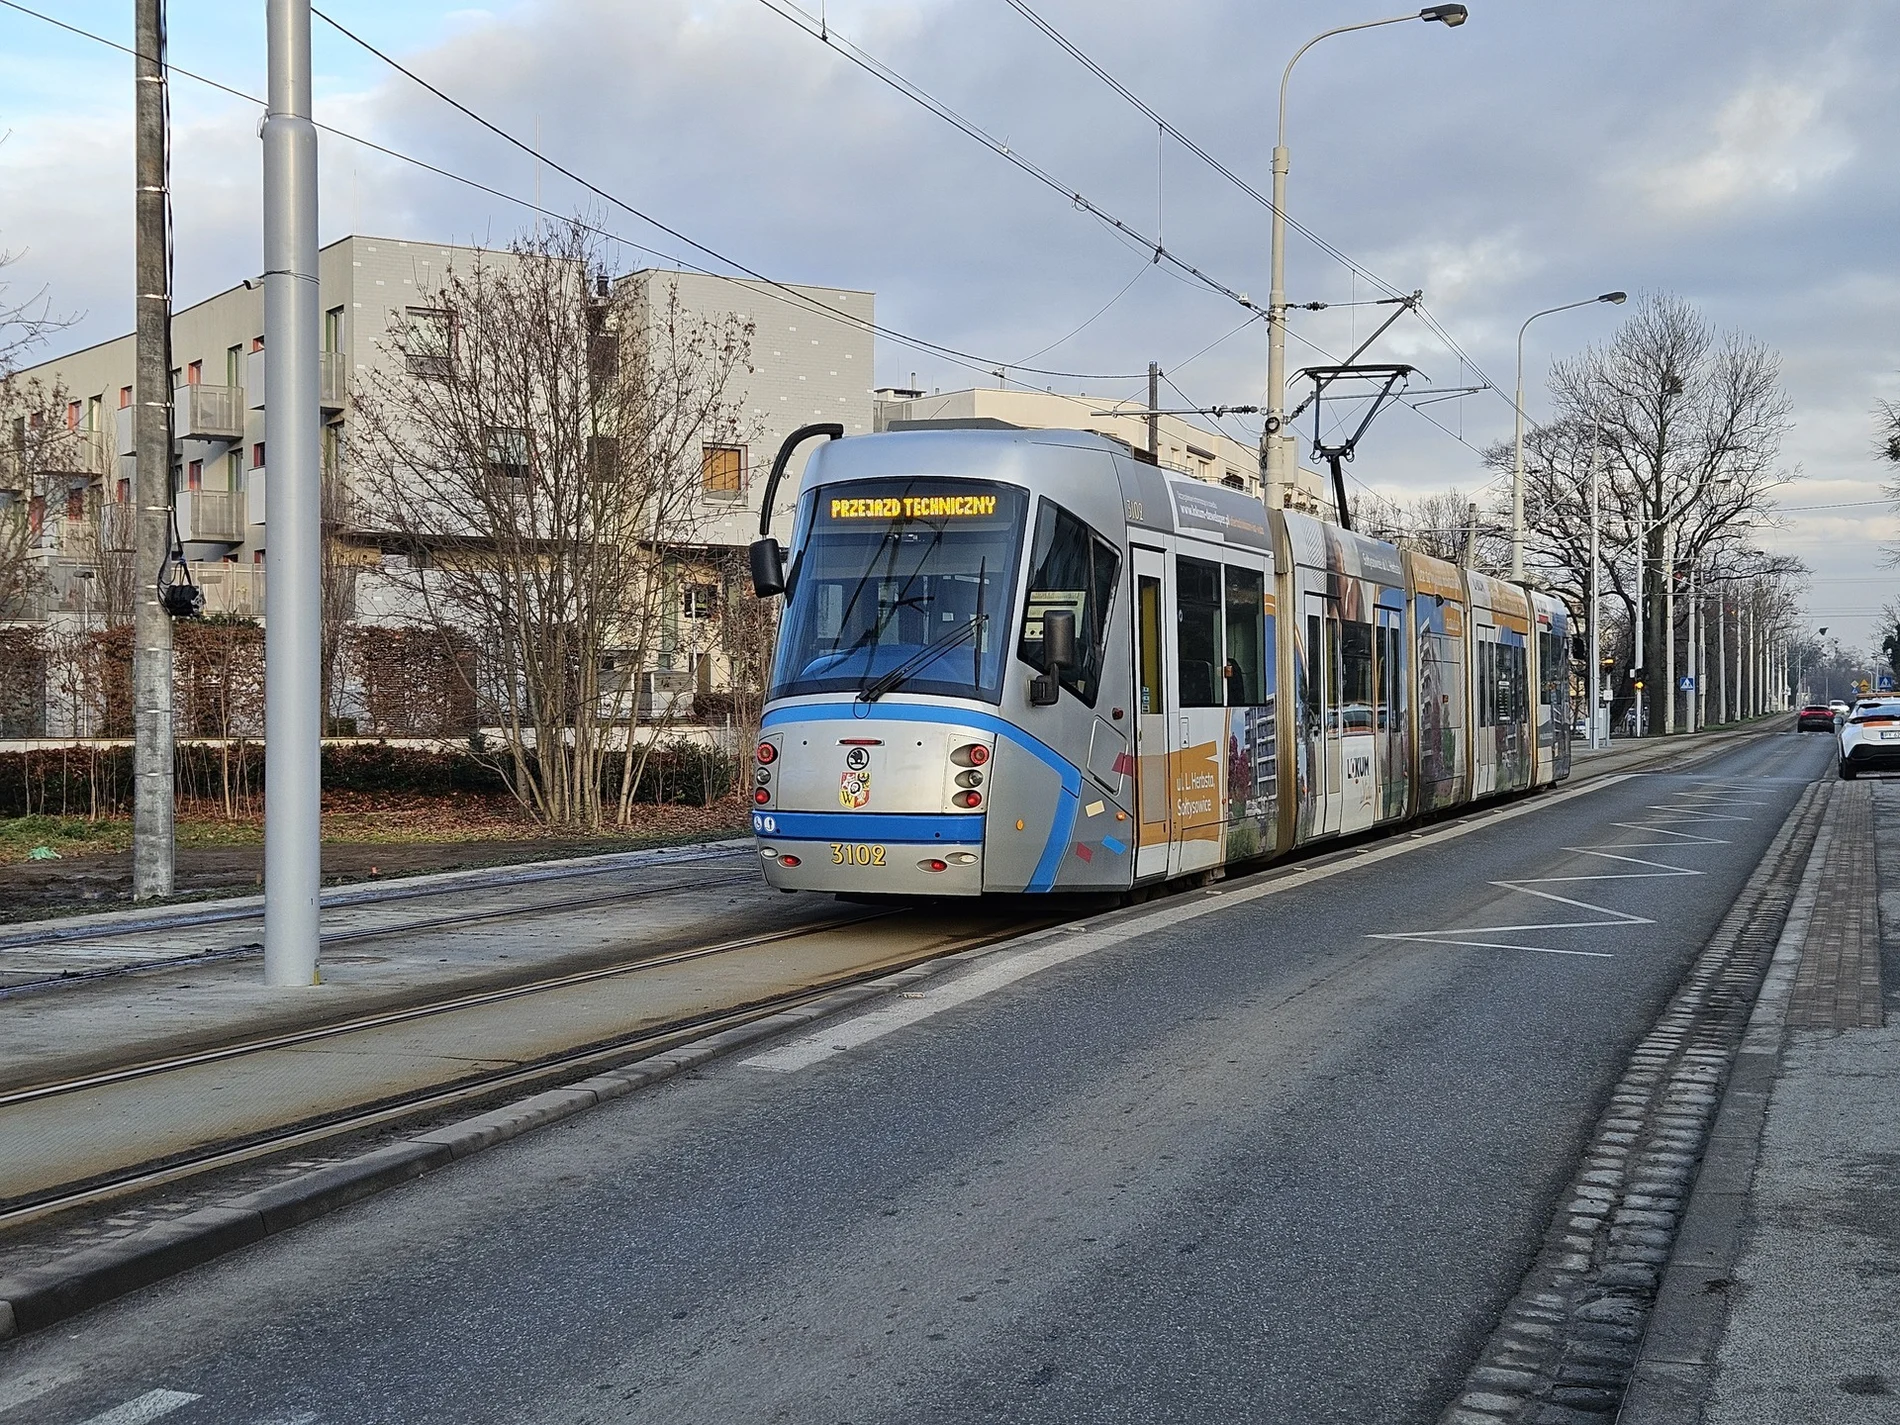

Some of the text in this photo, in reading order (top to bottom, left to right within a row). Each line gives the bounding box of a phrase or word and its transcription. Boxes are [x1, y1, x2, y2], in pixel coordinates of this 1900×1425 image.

[831, 496, 997, 518] PRZEJAZD TECHNICZNY
[1126, 499, 1144, 522] 3102
[830, 843, 886, 866] 3102
